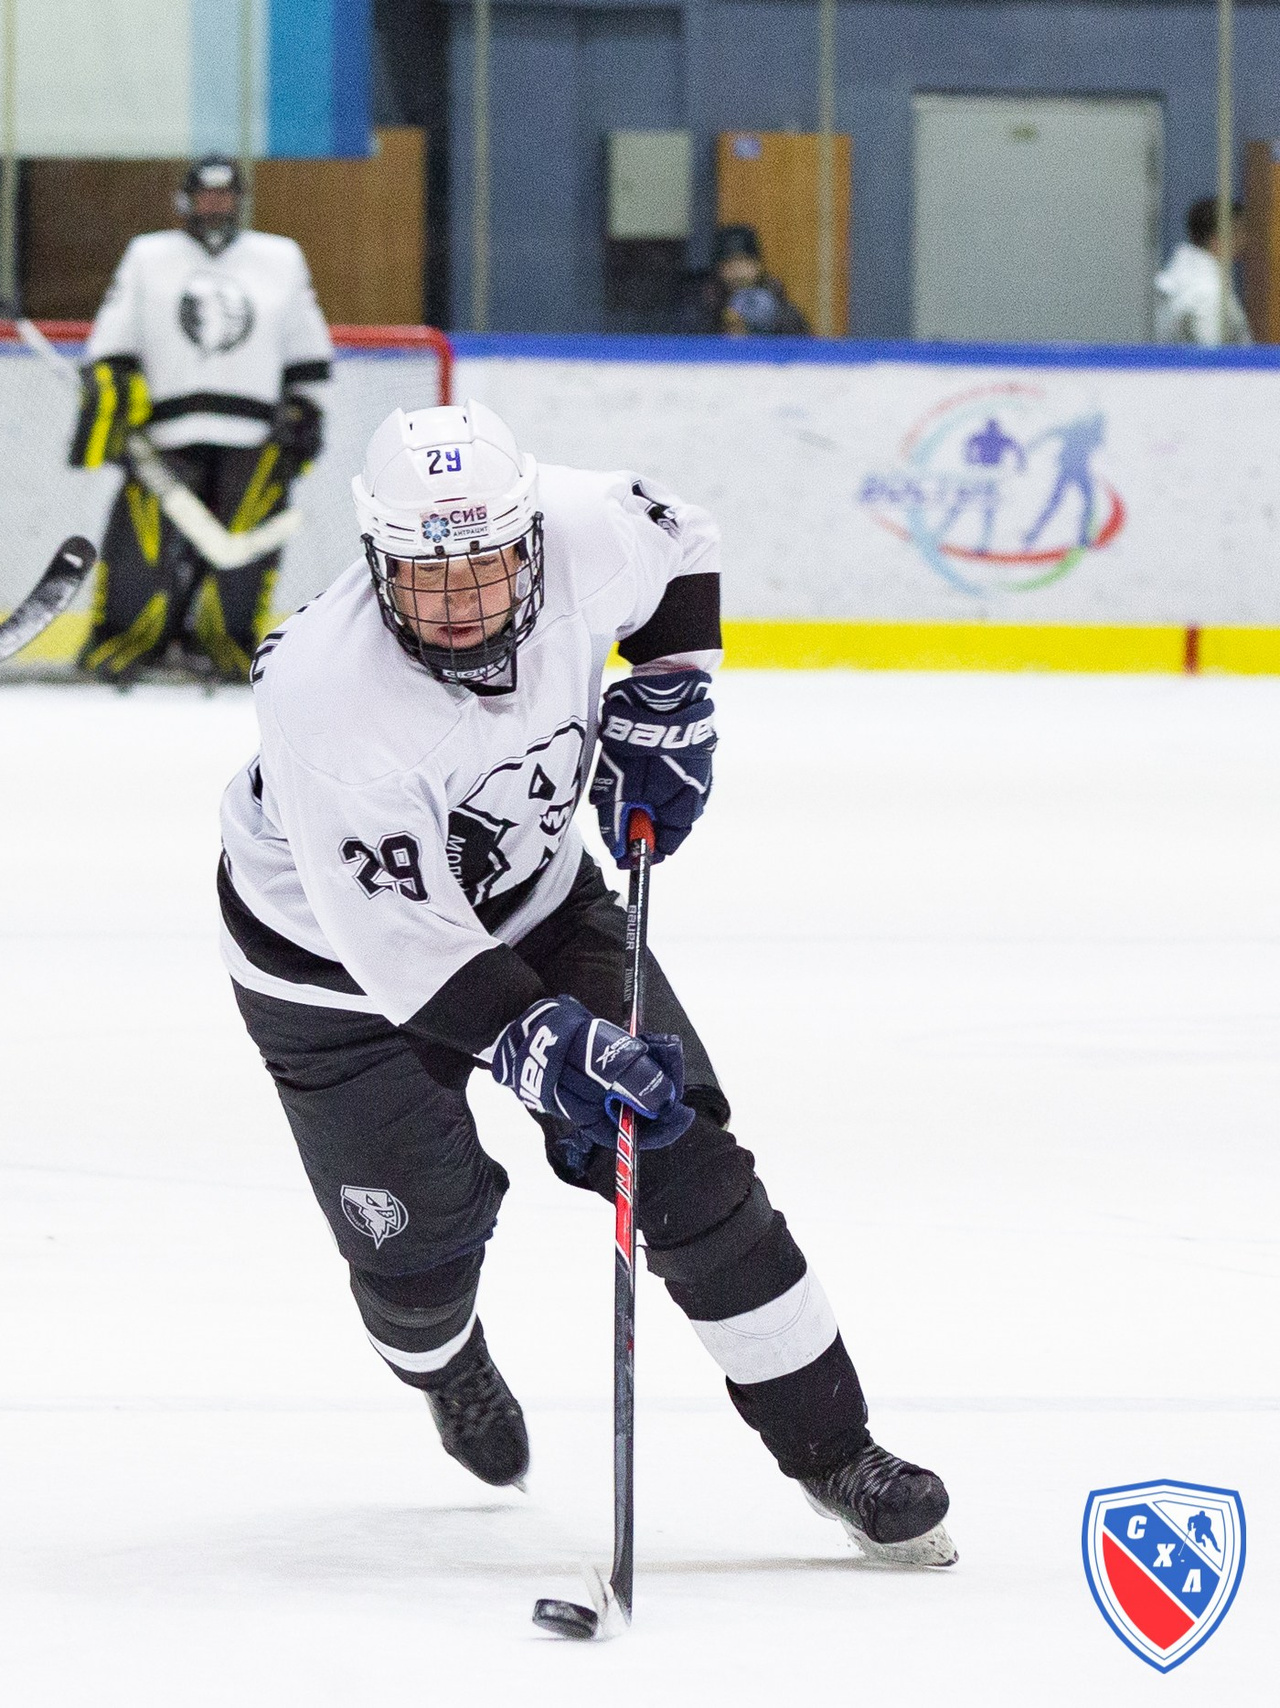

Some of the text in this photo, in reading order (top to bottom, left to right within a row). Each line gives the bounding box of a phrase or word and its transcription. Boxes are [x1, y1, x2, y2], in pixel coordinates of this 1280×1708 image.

[426, 447, 462, 475] 29
[449, 506, 488, 525] СИБ
[453, 526, 489, 538] АНТРАЦИТ
[602, 714, 716, 749] BAUE
[338, 830, 431, 904] 29
[625, 904, 638, 951] BAUER
